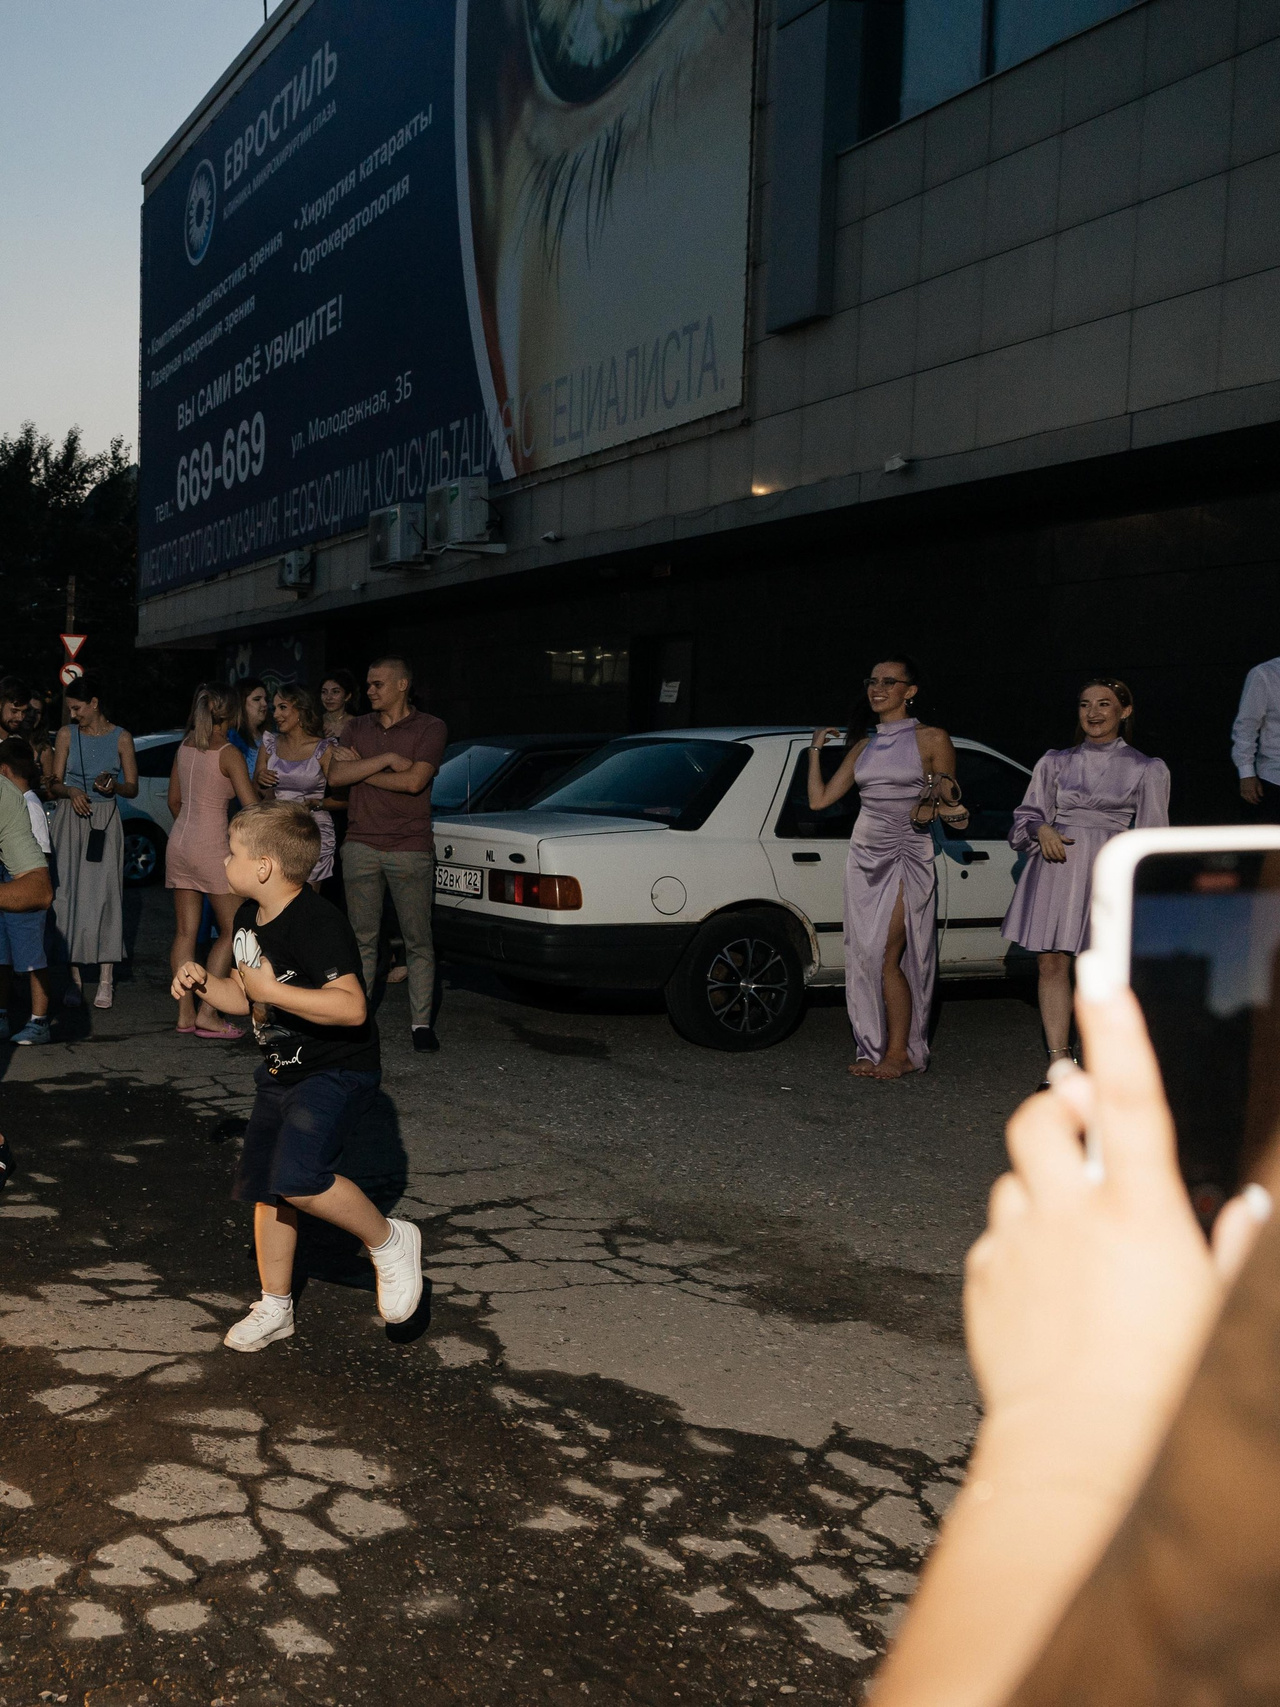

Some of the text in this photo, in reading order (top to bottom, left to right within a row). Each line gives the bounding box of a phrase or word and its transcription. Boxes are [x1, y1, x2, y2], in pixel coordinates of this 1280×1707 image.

[224, 41, 337, 191] ЕВРОСТИЛЬ
[300, 103, 432, 231] Хирургия катаракты
[249, 231, 283, 275] зрения
[300, 174, 409, 274] Ортокератология
[224, 294, 255, 334] зрения
[177, 294, 342, 431] ВЫ САМИ ВСЁ УВИДИТЕ!
[176, 411, 265, 511] 669-669
[291, 432, 305, 458] ул.
[308, 390, 391, 444] Молодежная,
[284, 458, 370, 540] НЕОБХОДИМА
[463, 871, 478, 887] 122
